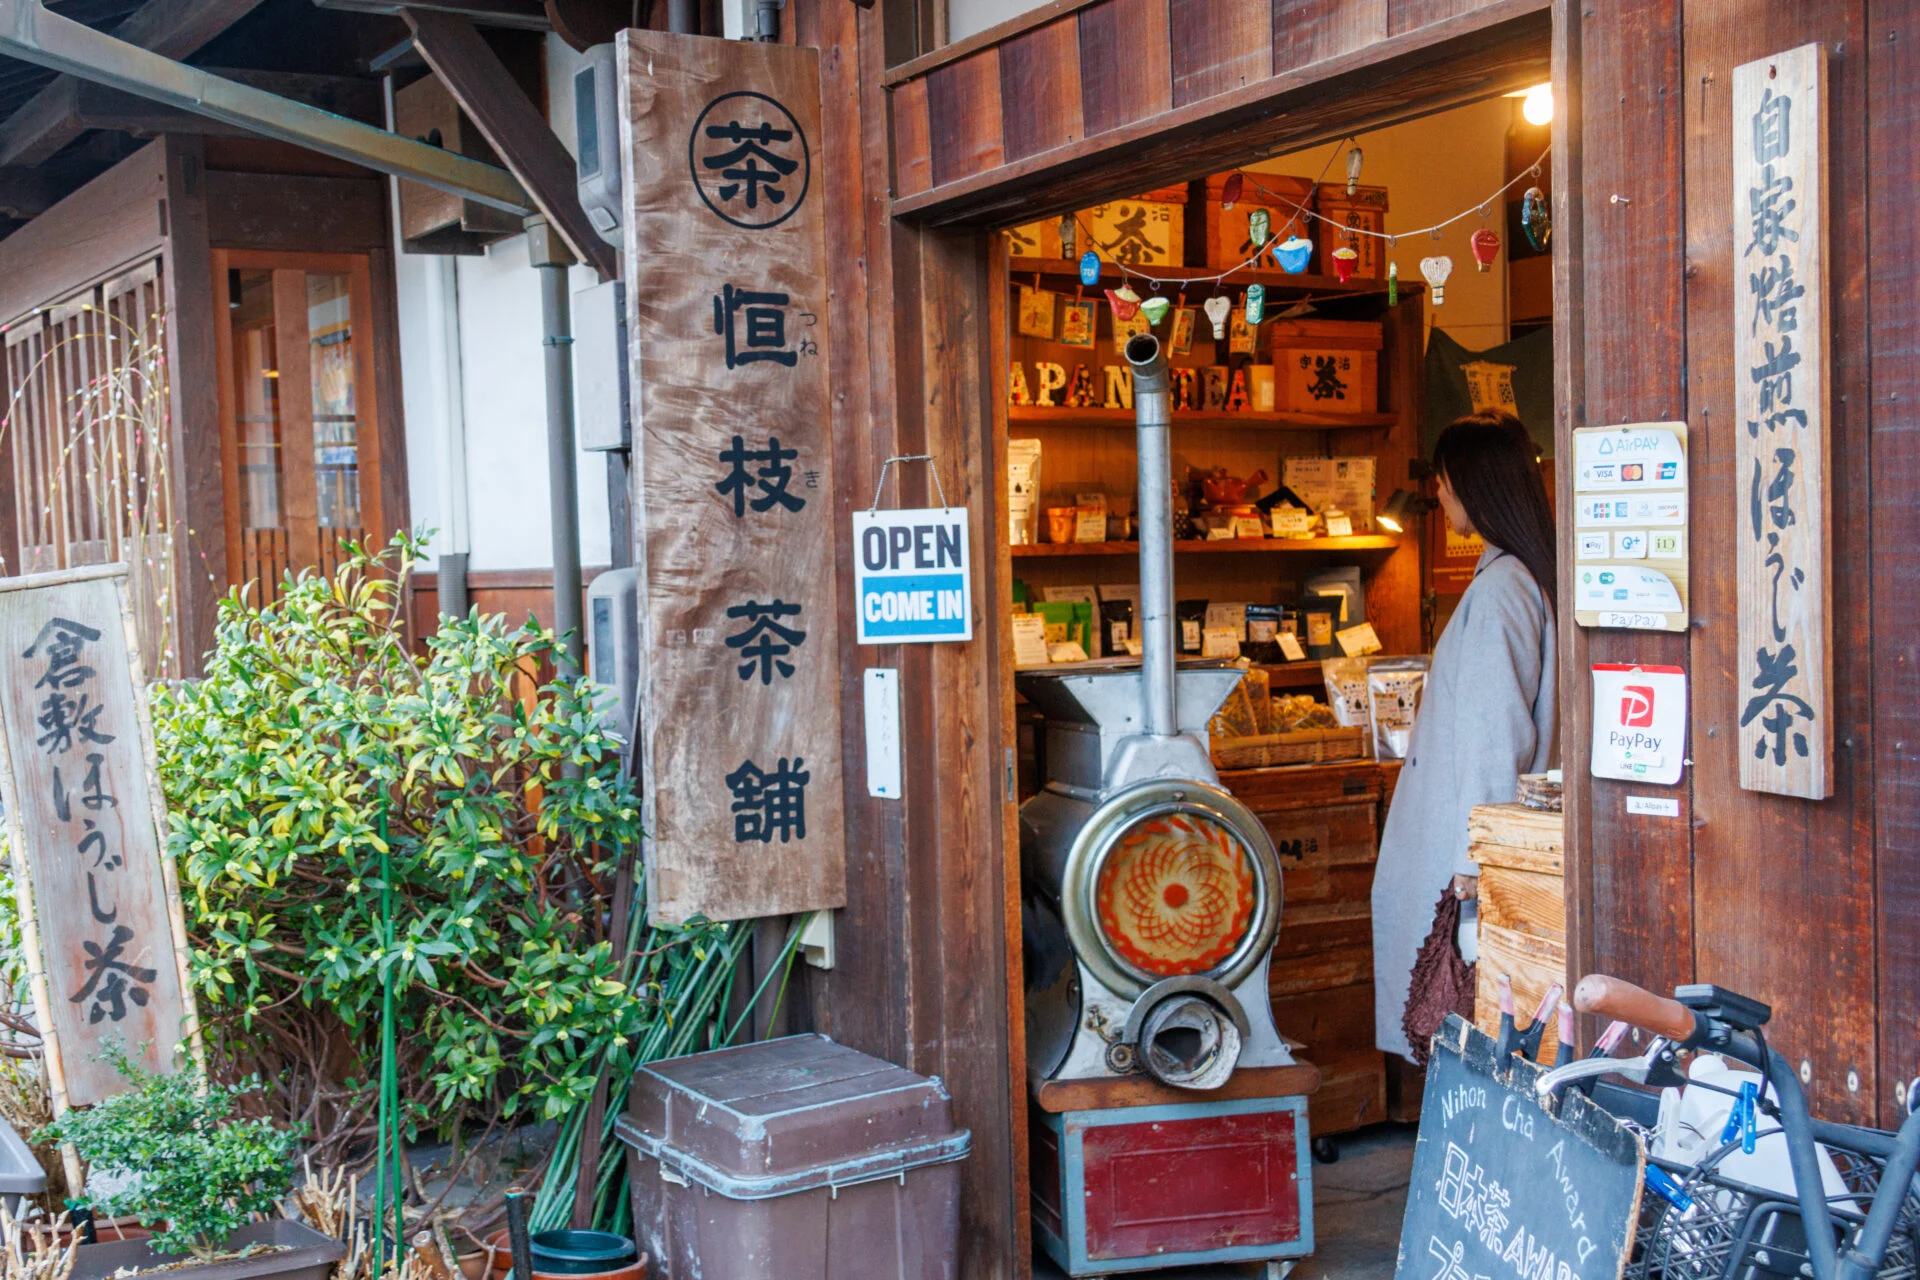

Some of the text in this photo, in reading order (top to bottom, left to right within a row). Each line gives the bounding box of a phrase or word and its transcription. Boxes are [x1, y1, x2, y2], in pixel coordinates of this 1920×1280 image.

[702, 120, 799, 209] 茶
[1101, 205, 1166, 264] 茶
[799, 312, 819, 357] つね
[1306, 355, 1348, 401] 茶
[1615, 437, 1659, 452] AirPAY
[1740, 87, 1815, 767] 自家焙煎ほうじ茶
[1596, 470, 1613, 478] VISA
[713, 283, 811, 844] 恒枝茶舗
[861, 523, 963, 571] OPEN
[864, 589, 964, 623] COME IN
[1610, 613, 1658, 628] PayPay
[1609, 731, 1662, 752] PayPay
[22, 616, 157, 1025] 倉敷ほうじ茶
[1441, 1083, 1487, 1129] Nihon
[1502, 1094, 1535, 1142] Cha
[1545, 1139, 1598, 1265] Award
